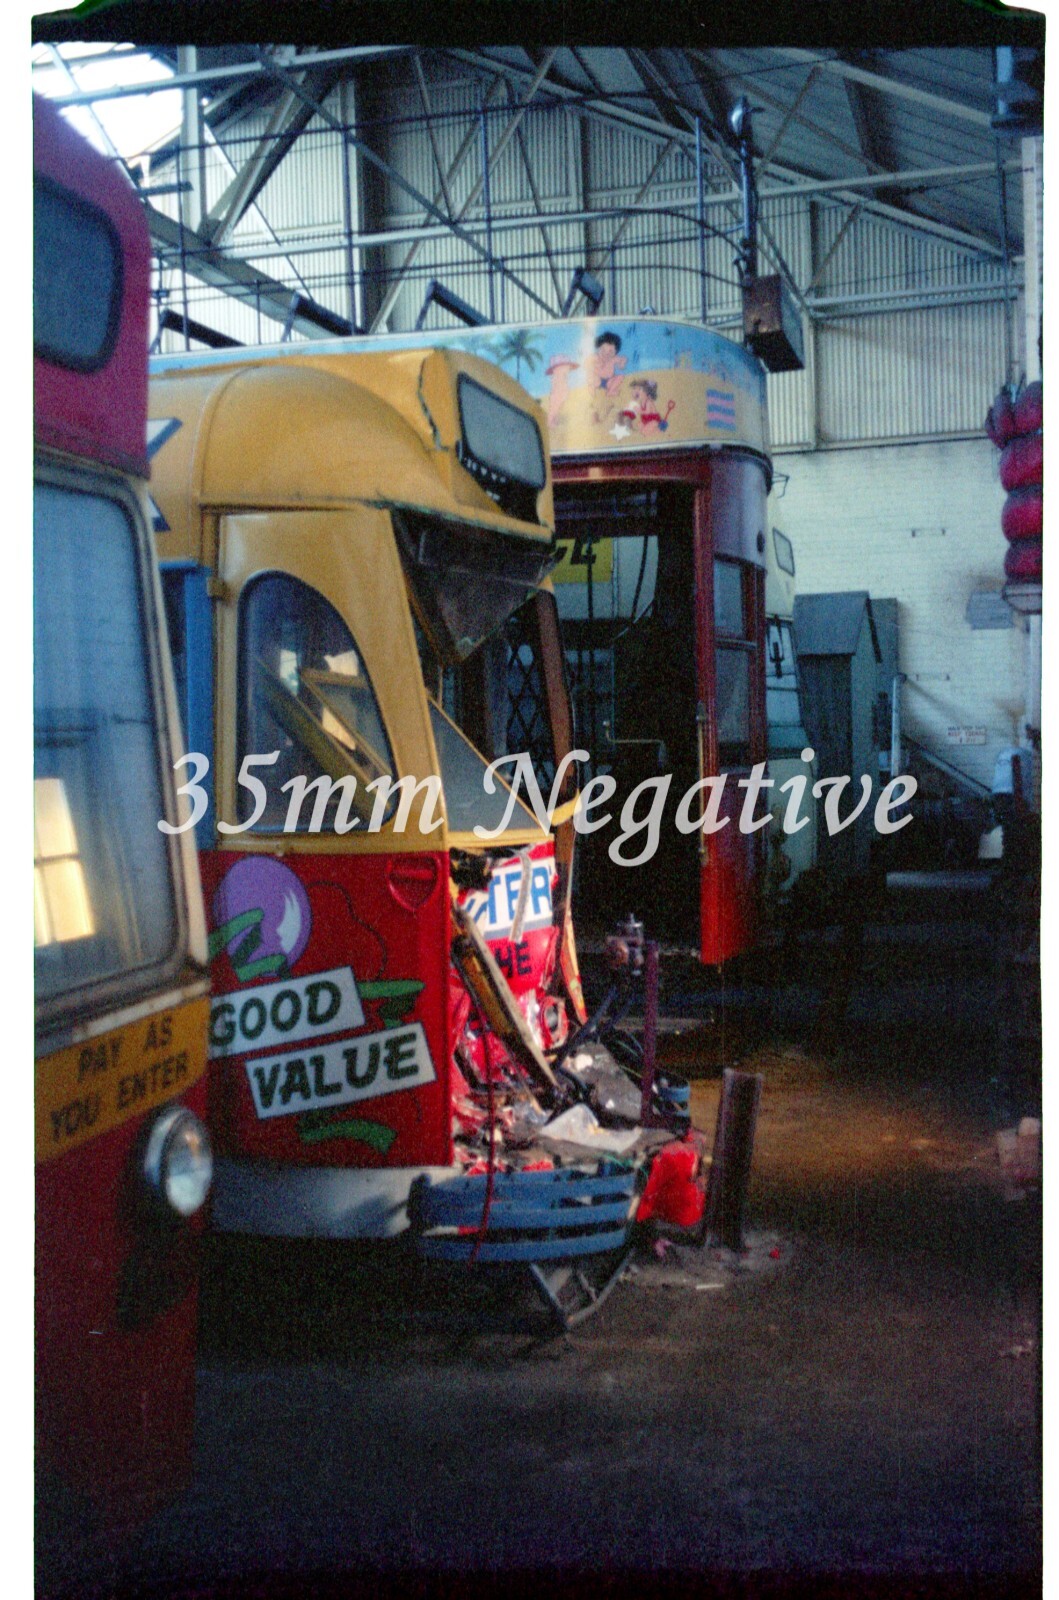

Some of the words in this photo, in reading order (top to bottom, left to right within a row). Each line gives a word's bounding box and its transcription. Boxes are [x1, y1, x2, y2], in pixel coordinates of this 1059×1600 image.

[78, 1034, 125, 1085] PAY
[145, 1014, 173, 1050] AS
[209, 980, 342, 1046] GOOD
[51, 1092, 101, 1143] YOU
[117, 1051, 188, 1110] ENTER
[253, 1032, 419, 1109] VALUE
